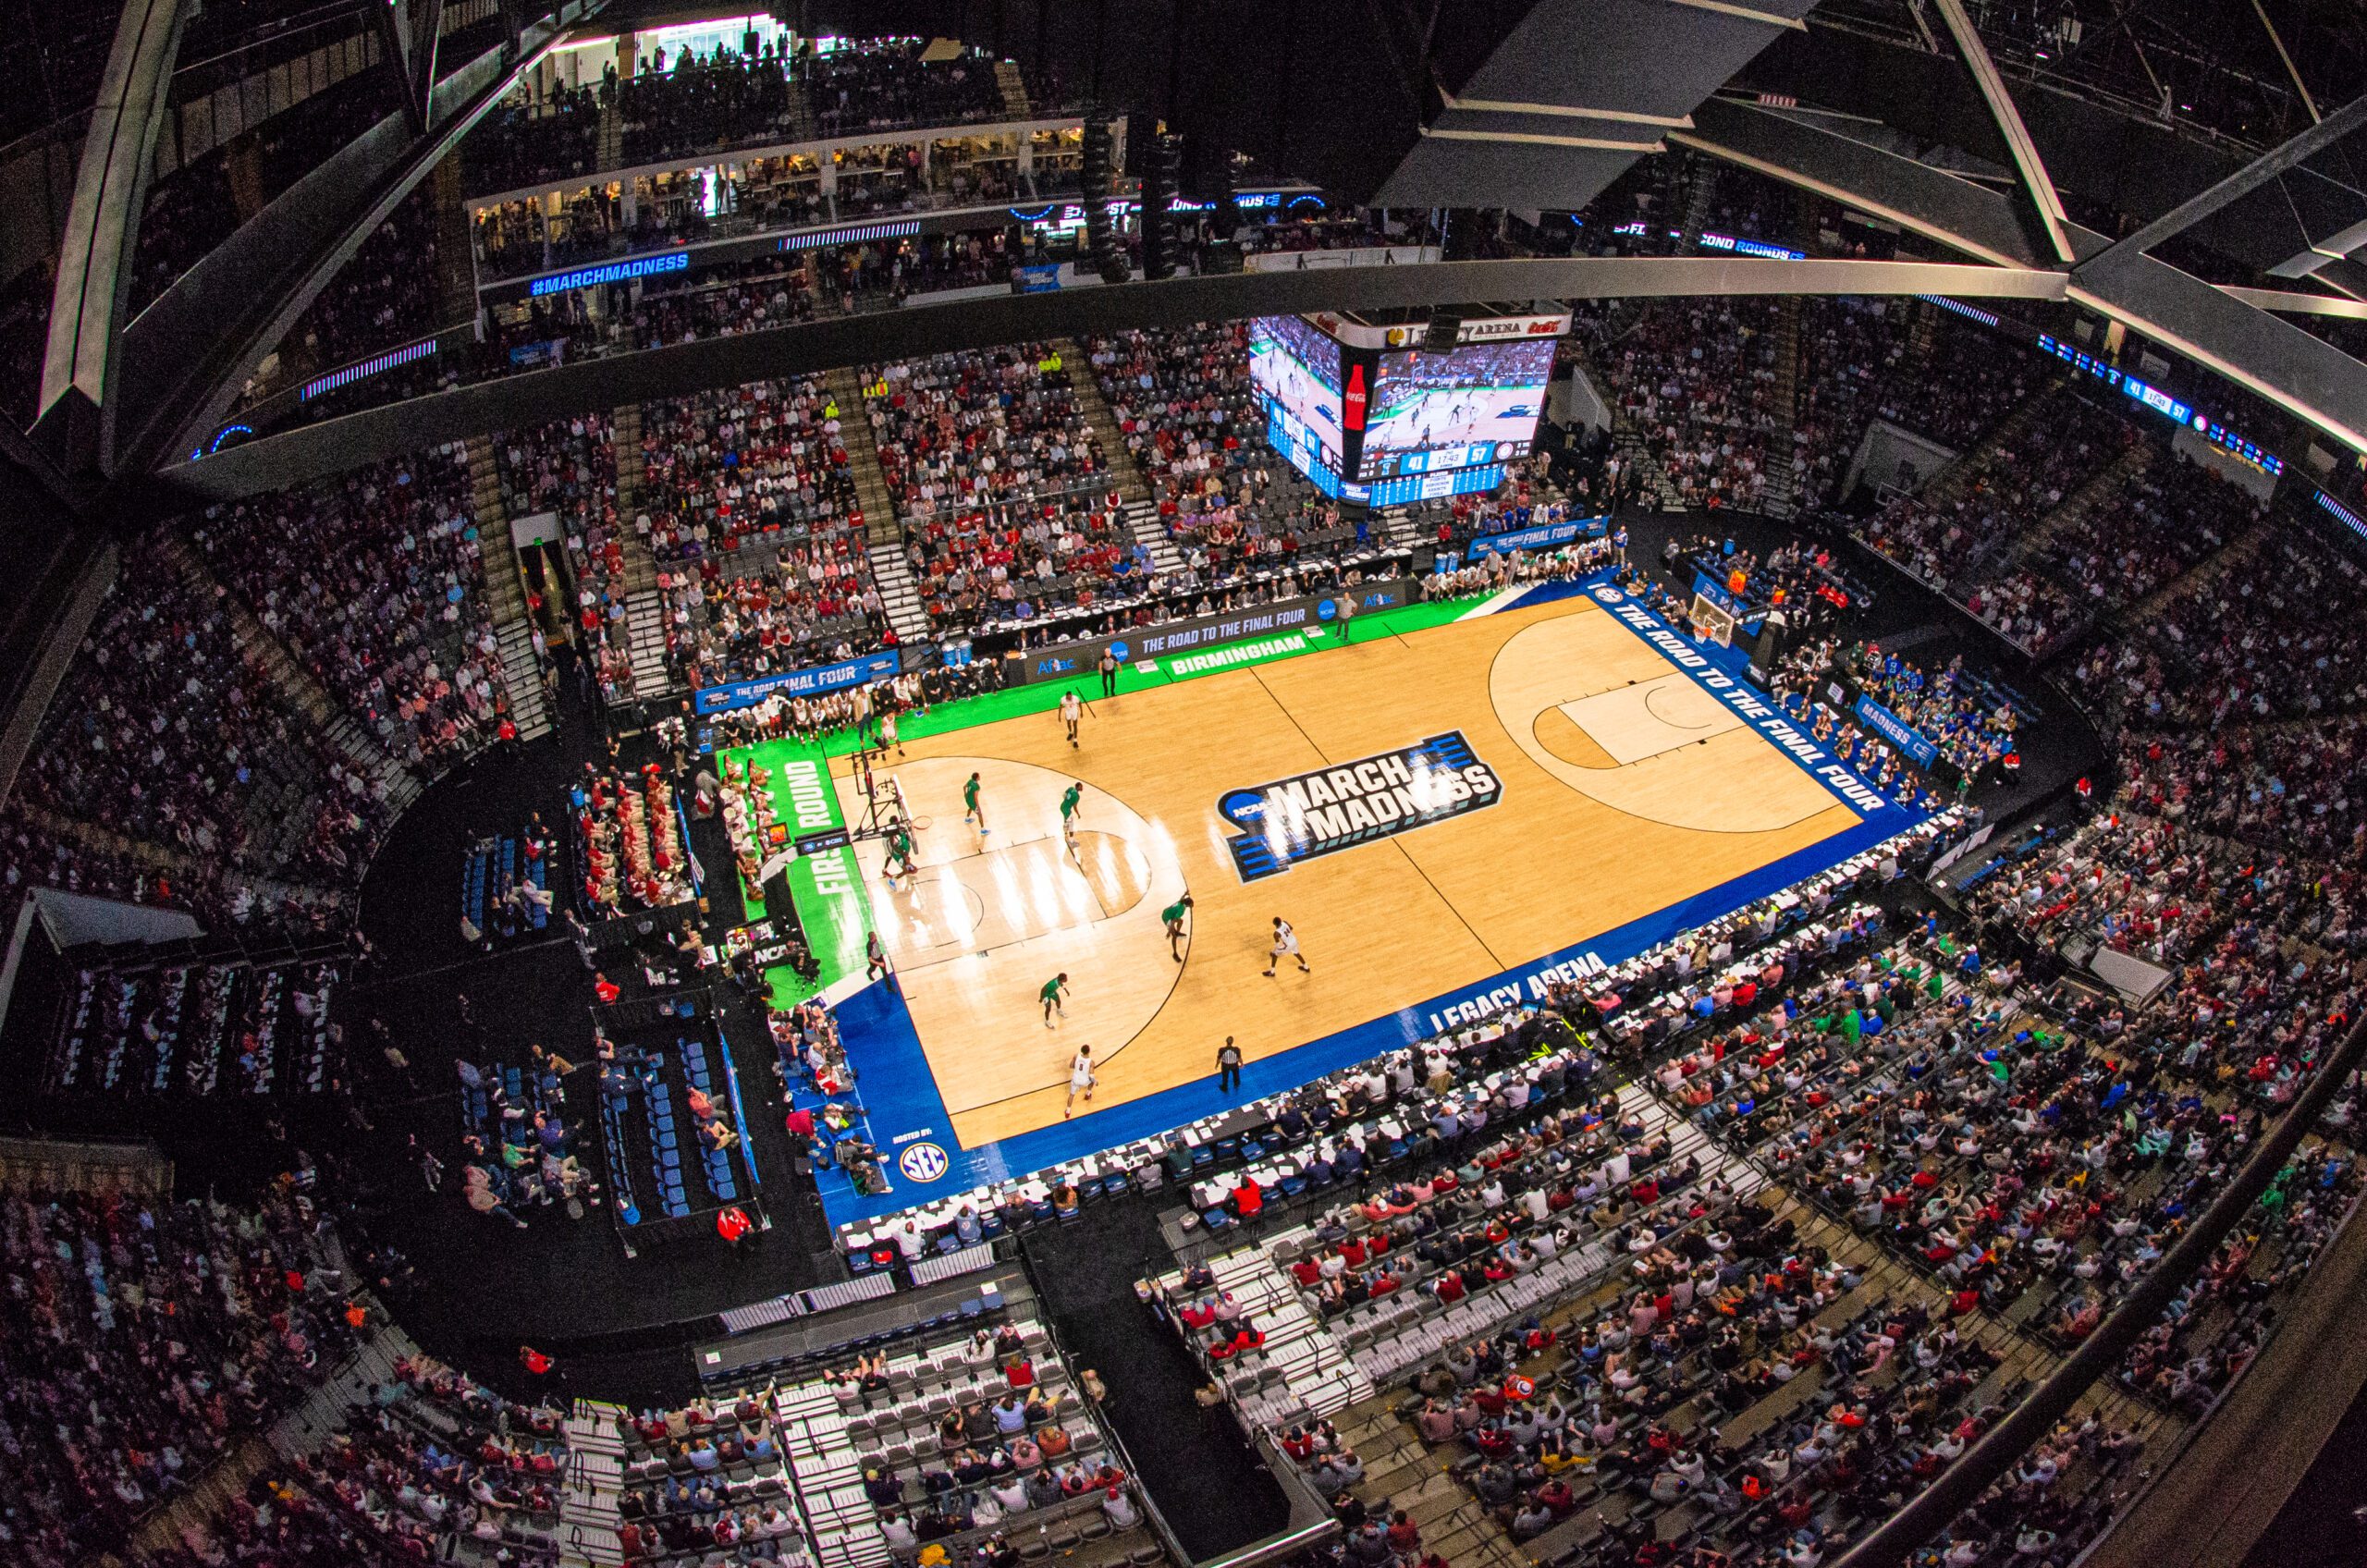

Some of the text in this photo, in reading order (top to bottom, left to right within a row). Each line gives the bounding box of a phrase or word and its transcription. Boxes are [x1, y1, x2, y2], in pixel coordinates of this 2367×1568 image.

[531, 253, 689, 296] #MARCHMADNESS
[1475, 323, 1521, 335] ARENA
[1408, 456, 1424, 471] 41
[1438, 454, 1459, 464] 17:43
[1471, 447, 1488, 462] 57
[1523, 529, 1550, 545] FINAL
[1551, 525, 1577, 540] FOUR
[1143, 608, 1306, 654] THE ROAD TO THE FINAL FOUR
[1171, 635, 1306, 676] BIRMINGHAM
[736, 687, 752, 696] THE
[818, 666, 856, 686] FOUR
[1614, 604, 1661, 630] THE
[1646, 630, 1708, 668] ROAD
[1697, 668, 1734, 688] TO
[1723, 688, 1773, 719] THE
[1759, 718, 1826, 765] FINAL
[1816, 765, 1885, 812] FOUR
[1861, 703, 1911, 745] MADNESS
[784, 760, 832, 828] ROUND
[1267, 754, 1413, 815] MARCH
[754, 944, 787, 964] NCA
[892, 1130, 920, 1145] HOSTED
[903, 1145, 945, 1180] SEC
